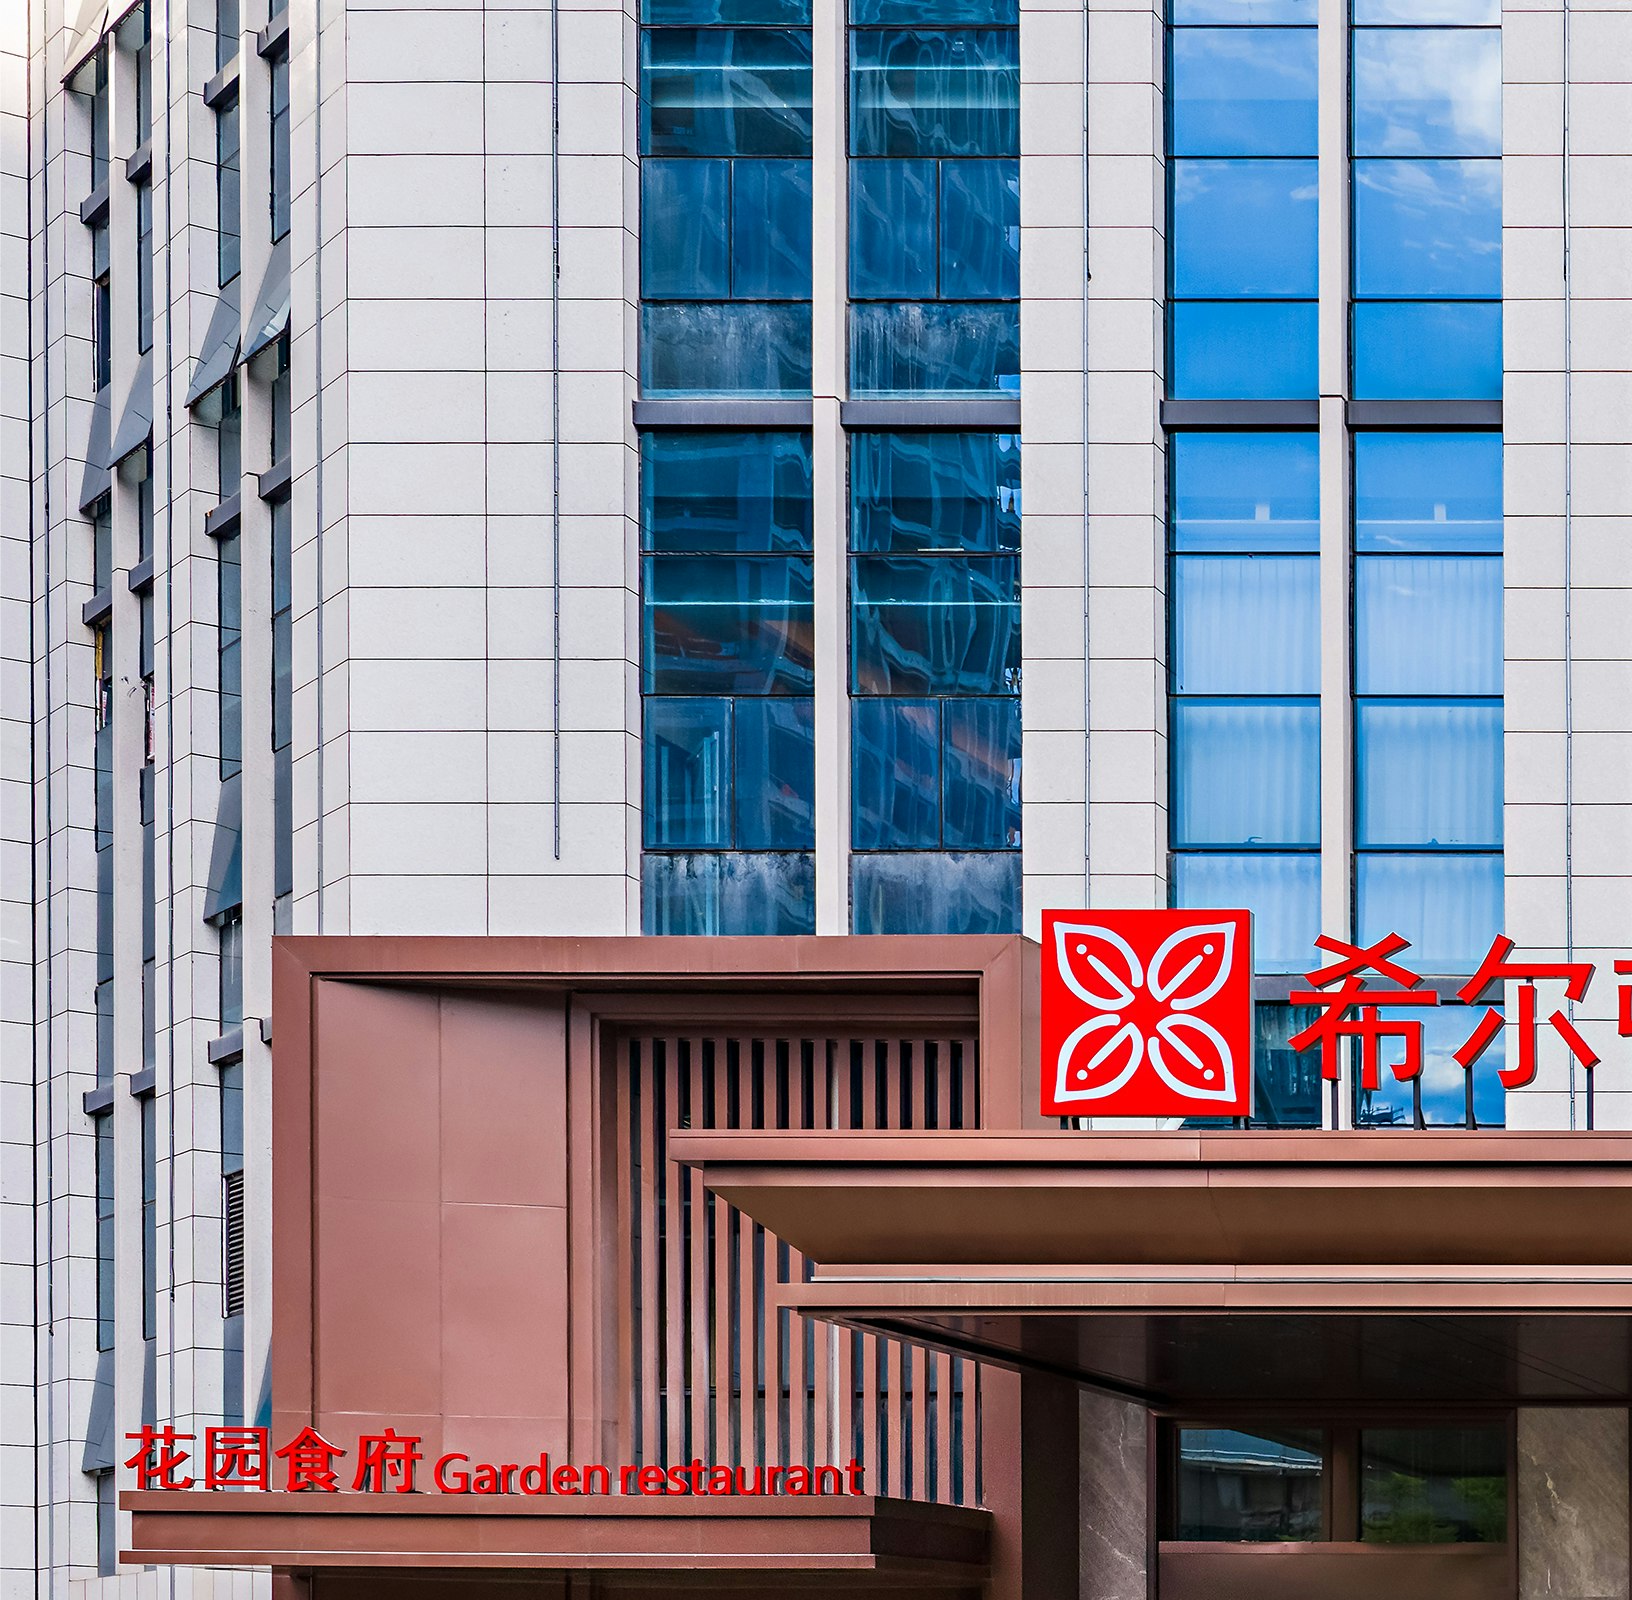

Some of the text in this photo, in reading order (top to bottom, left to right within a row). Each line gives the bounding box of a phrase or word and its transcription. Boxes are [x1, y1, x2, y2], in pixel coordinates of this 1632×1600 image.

[125, 1425, 422, 1493] 花园食府
[433, 1453, 863, 1497] Garden restaurant
